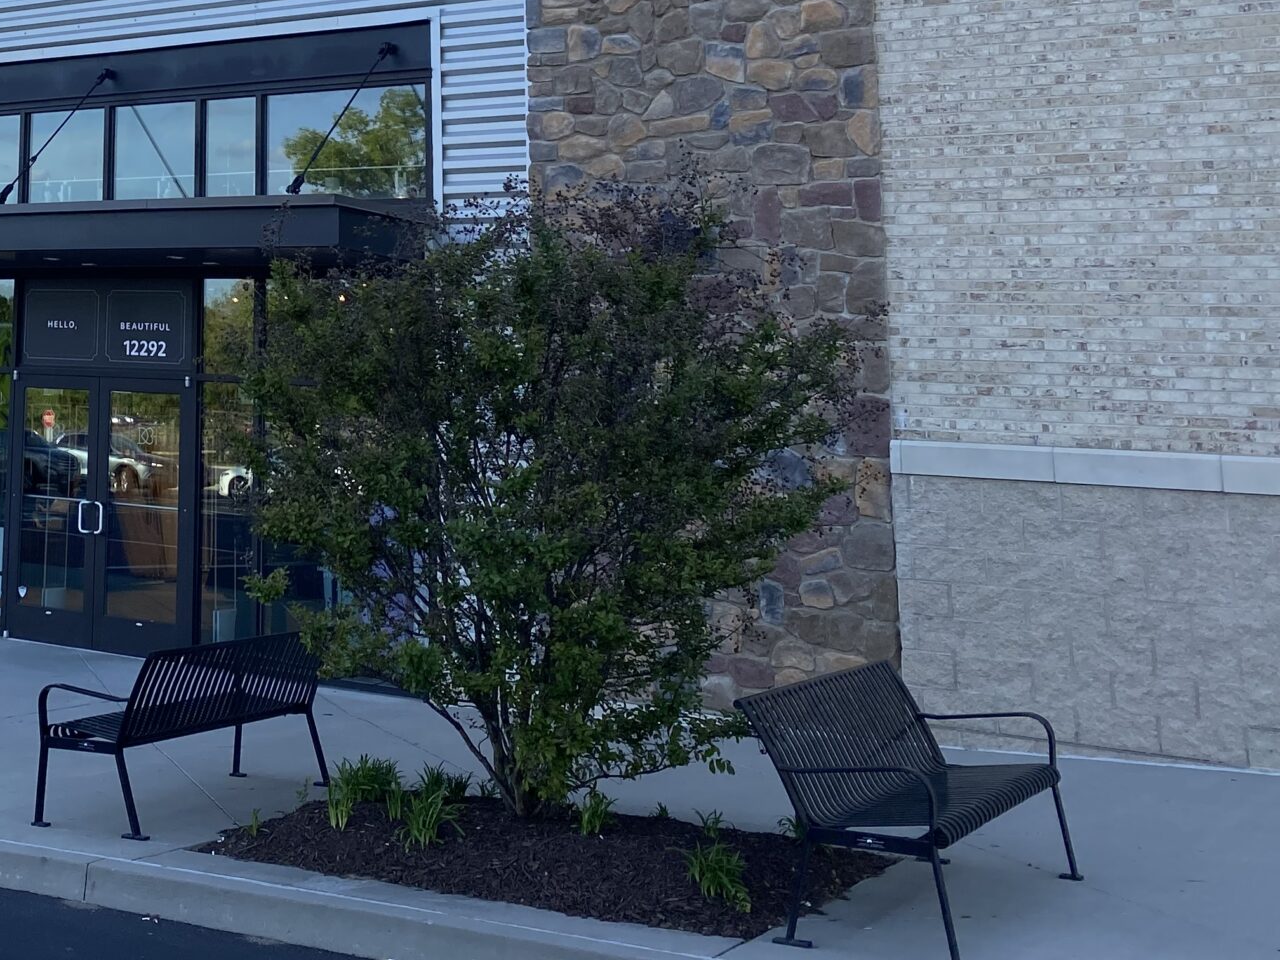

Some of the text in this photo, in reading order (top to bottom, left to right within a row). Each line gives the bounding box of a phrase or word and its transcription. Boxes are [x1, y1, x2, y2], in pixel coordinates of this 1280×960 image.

[47, 320, 170, 332] HELLO, BEAUTIFUL
[123, 340, 167, 357] 12292
